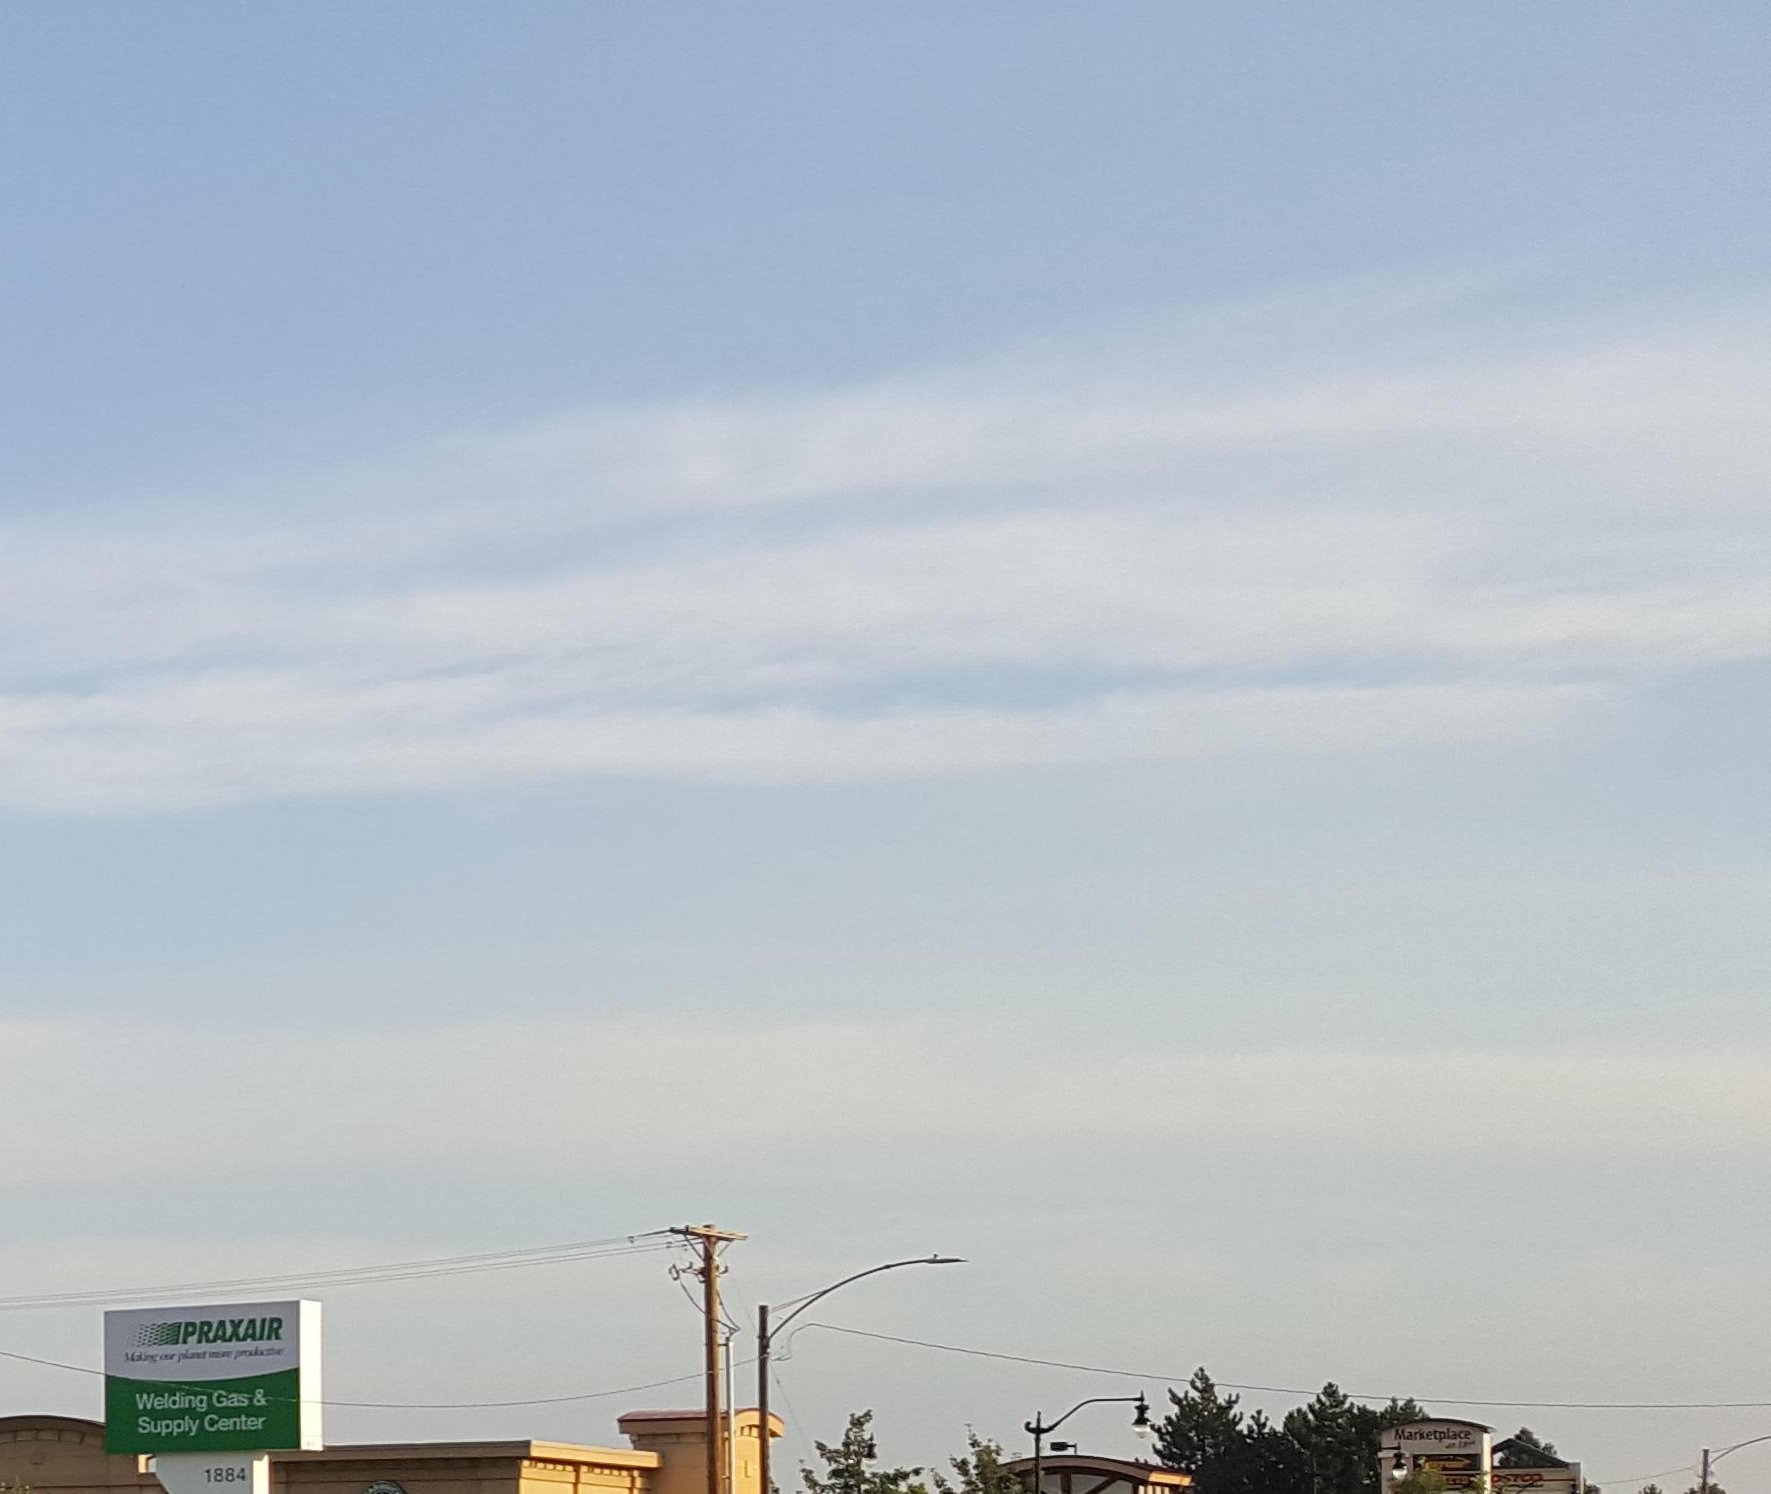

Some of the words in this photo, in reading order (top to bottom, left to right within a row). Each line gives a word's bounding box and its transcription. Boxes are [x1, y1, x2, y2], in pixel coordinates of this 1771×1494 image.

[181, 1317, 283, 1346] PRAXAIR
[123, 1350, 158, 1364] Making
[160, 1352, 174, 1361] our
[177, 1350, 207, 1363] planet
[234, 1346, 284, 1360] productive
[135, 1391, 208, 1412] Welding
[212, 1390, 250, 1408] Gas
[253, 1388, 268, 1406] &
[137, 1415, 199, 1436] Supply
[203, 1414, 267, 1432] Center
[1395, 1427, 1472, 1443] Marketplace
[204, 1467, 246, 1483] 1884
